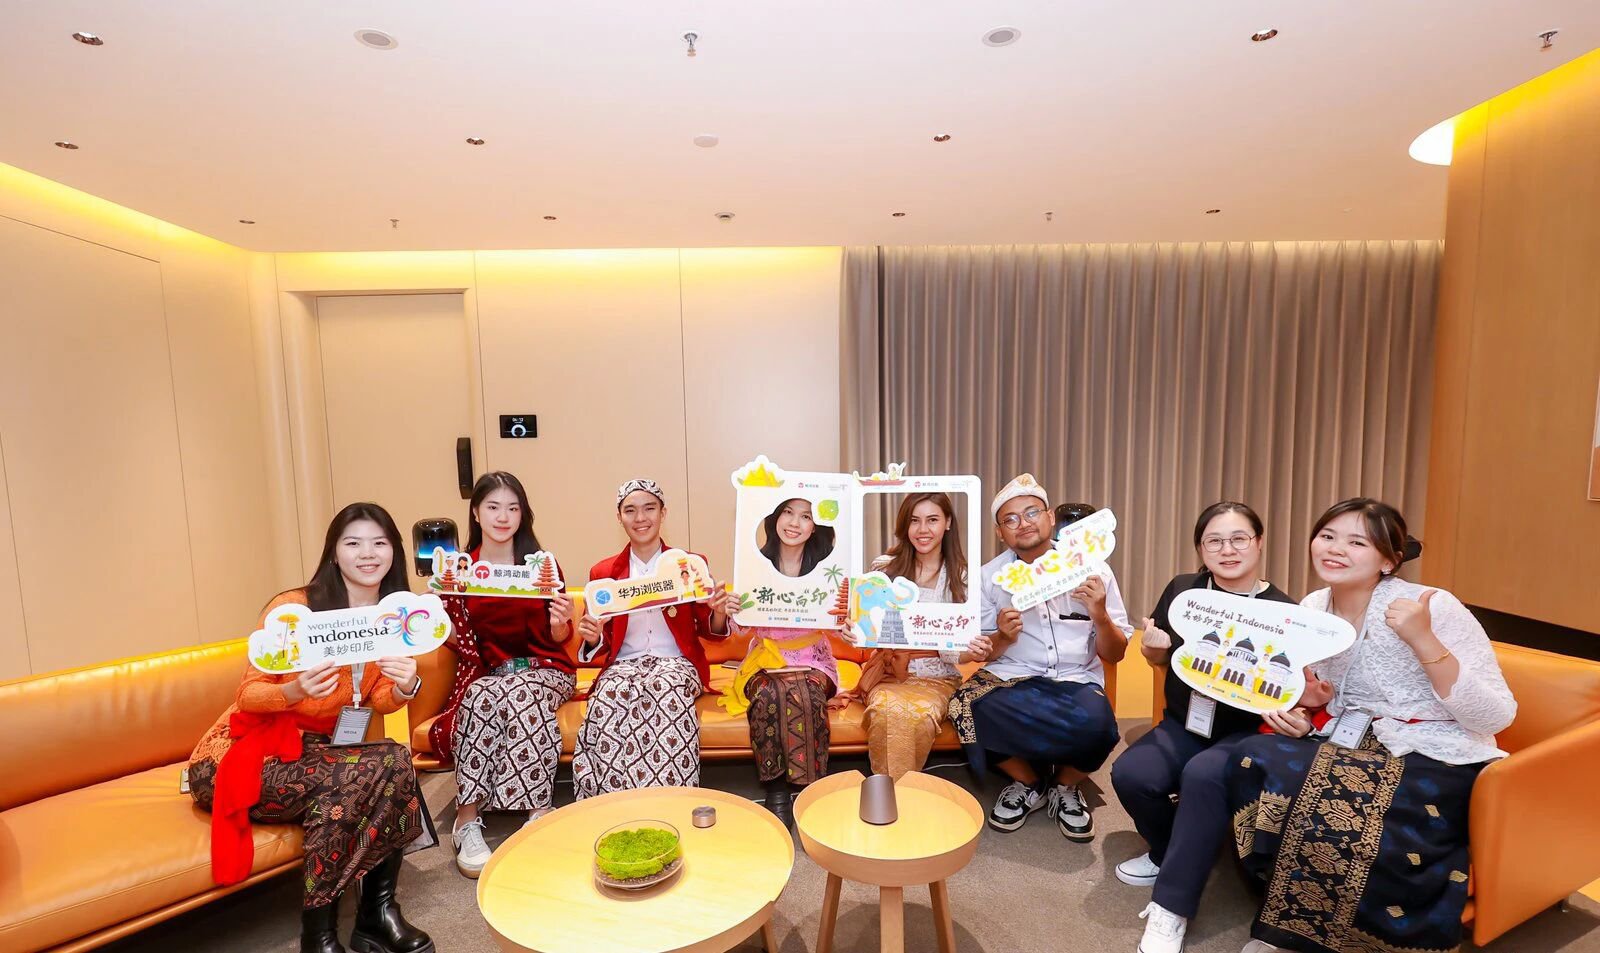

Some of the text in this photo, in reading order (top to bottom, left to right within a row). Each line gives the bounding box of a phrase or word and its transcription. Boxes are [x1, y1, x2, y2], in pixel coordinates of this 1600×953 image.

[493, 569, 531, 579] 鲸鸿动能
[618, 580, 675, 599] 华为浏览器
[307, 616, 368, 631] wonderful
[1182, 610, 1224, 630] 美妙印尼
[1187, 599, 1285, 635] Wonderful Indonesia
[308, 626, 390, 645] indonesia
[323, 640, 375, 658] 美妙印尼
